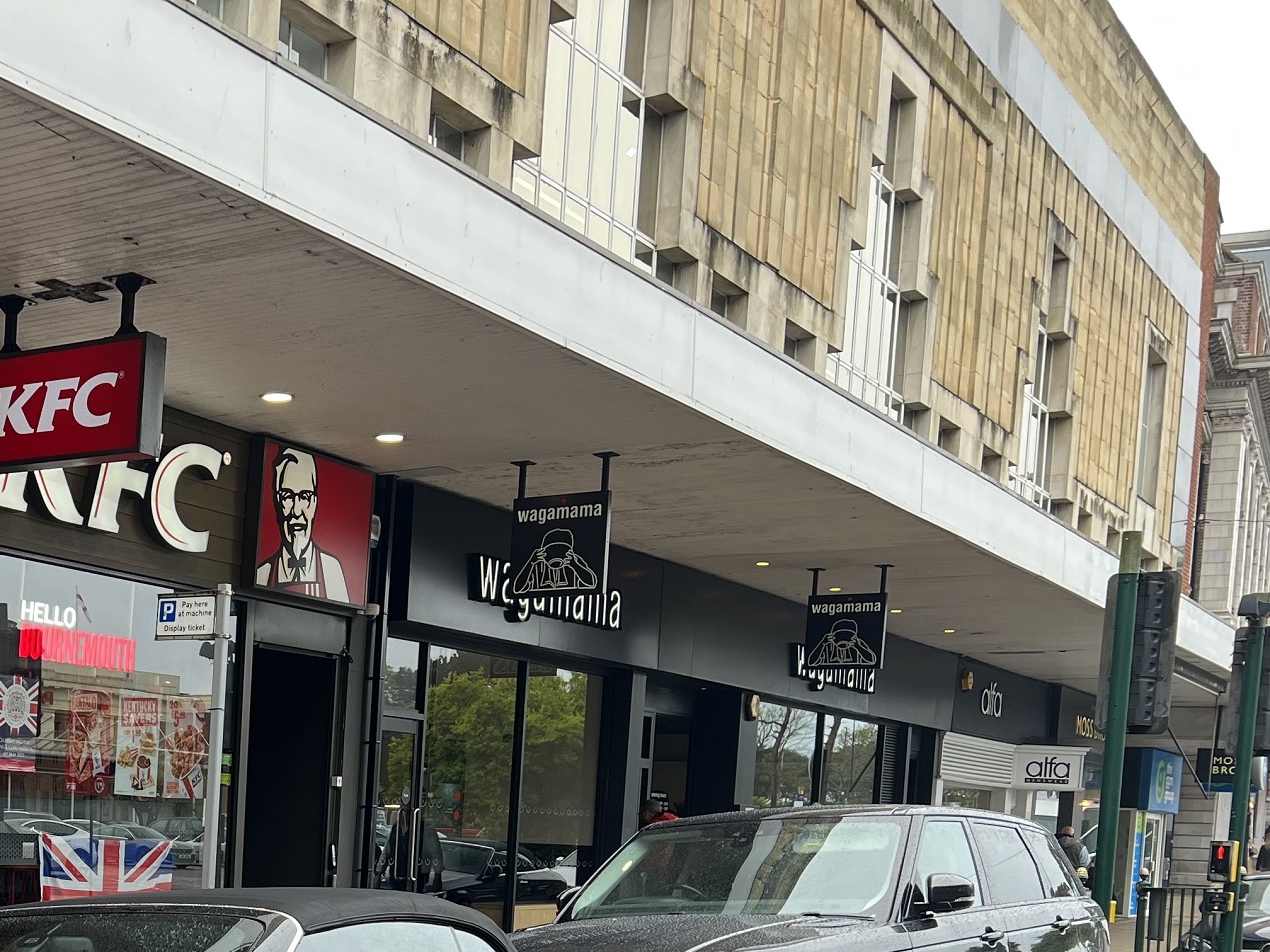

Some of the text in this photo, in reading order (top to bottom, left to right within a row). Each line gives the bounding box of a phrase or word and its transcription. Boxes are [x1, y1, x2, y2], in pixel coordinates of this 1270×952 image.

[517, 502, 602, 524] wagamama
[21, 599, 77, 629] HELLO
[811, 600, 881, 615] wagamama
[123, 700, 156, 713] KENTUCKY
[981, 682, 1003, 717] alfa
[1026, 757, 1070, 778] alfa
[1213, 757, 1236, 765] MO
